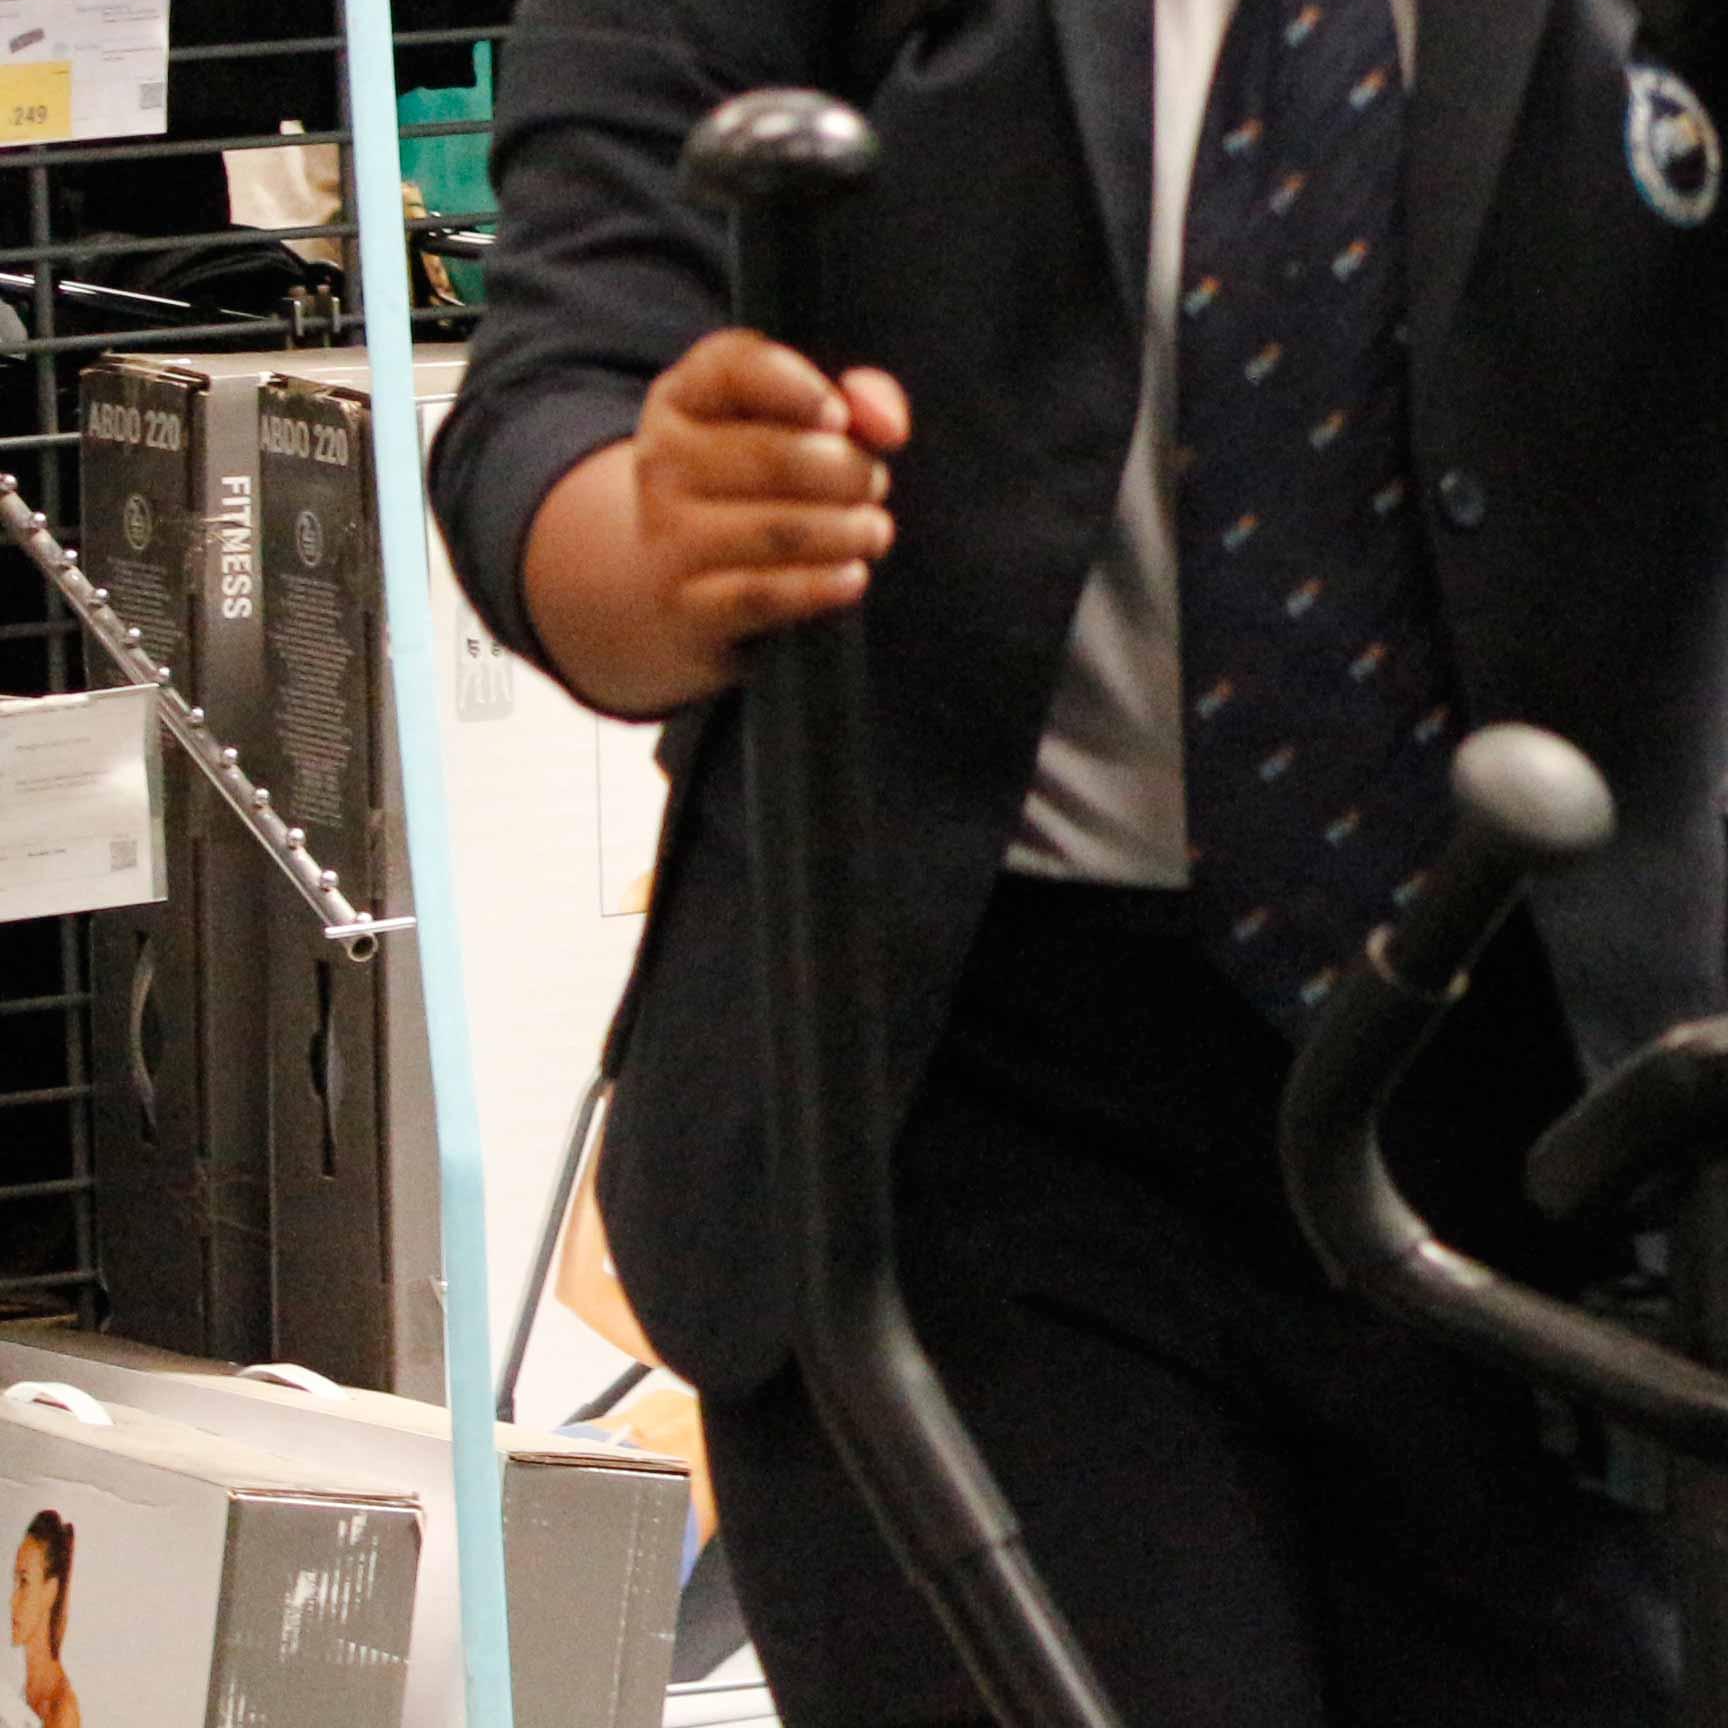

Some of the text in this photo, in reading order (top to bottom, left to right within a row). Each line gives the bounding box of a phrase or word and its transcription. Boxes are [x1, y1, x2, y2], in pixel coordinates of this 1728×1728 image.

[88, 401, 182, 452] ABDO 220
[260, 413, 350, 467] ABDO 220
[220, 474, 253, 620] FITNESS
